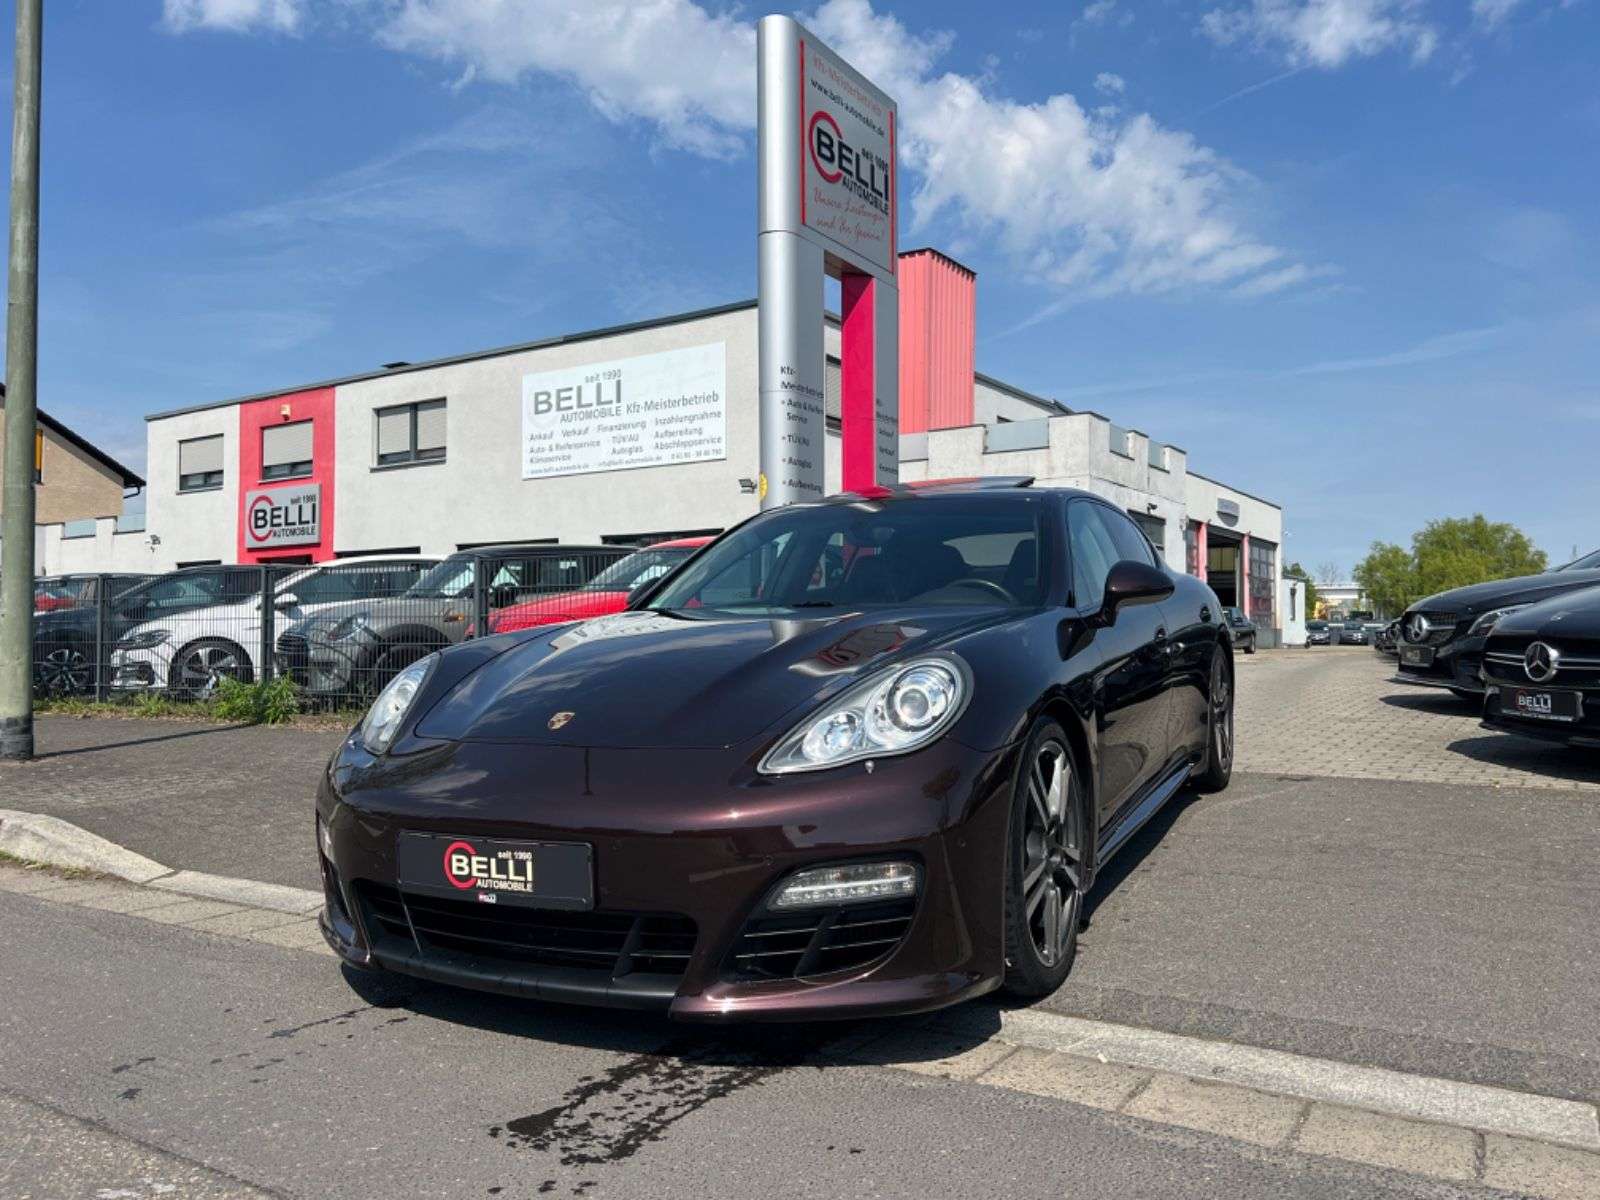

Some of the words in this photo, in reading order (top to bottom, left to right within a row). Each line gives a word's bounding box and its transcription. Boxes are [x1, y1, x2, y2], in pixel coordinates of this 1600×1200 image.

[817, 127, 889, 202] BELLI
[842, 177, 889, 216] AUTOMOBILE
[585, 373, 600, 383] seit
[534, 379, 622, 415] BELLI
[626, 390, 719, 414] Kfz-Meisterbetrieb
[560, 406, 622, 423] AUTOMOBILE
[562, 427, 589, 438] Verkauf
[597, 420, 647, 432] Finanzierung
[654, 428, 703, 439] Aufbereitung
[254, 502, 317, 530] BELLI
[272, 526, 317, 538] AUTOMOBILE
[497, 850, 512, 859] seit
[451, 854, 533, 882] BELLI
[476, 878, 533, 892] AUTOMOBILE
